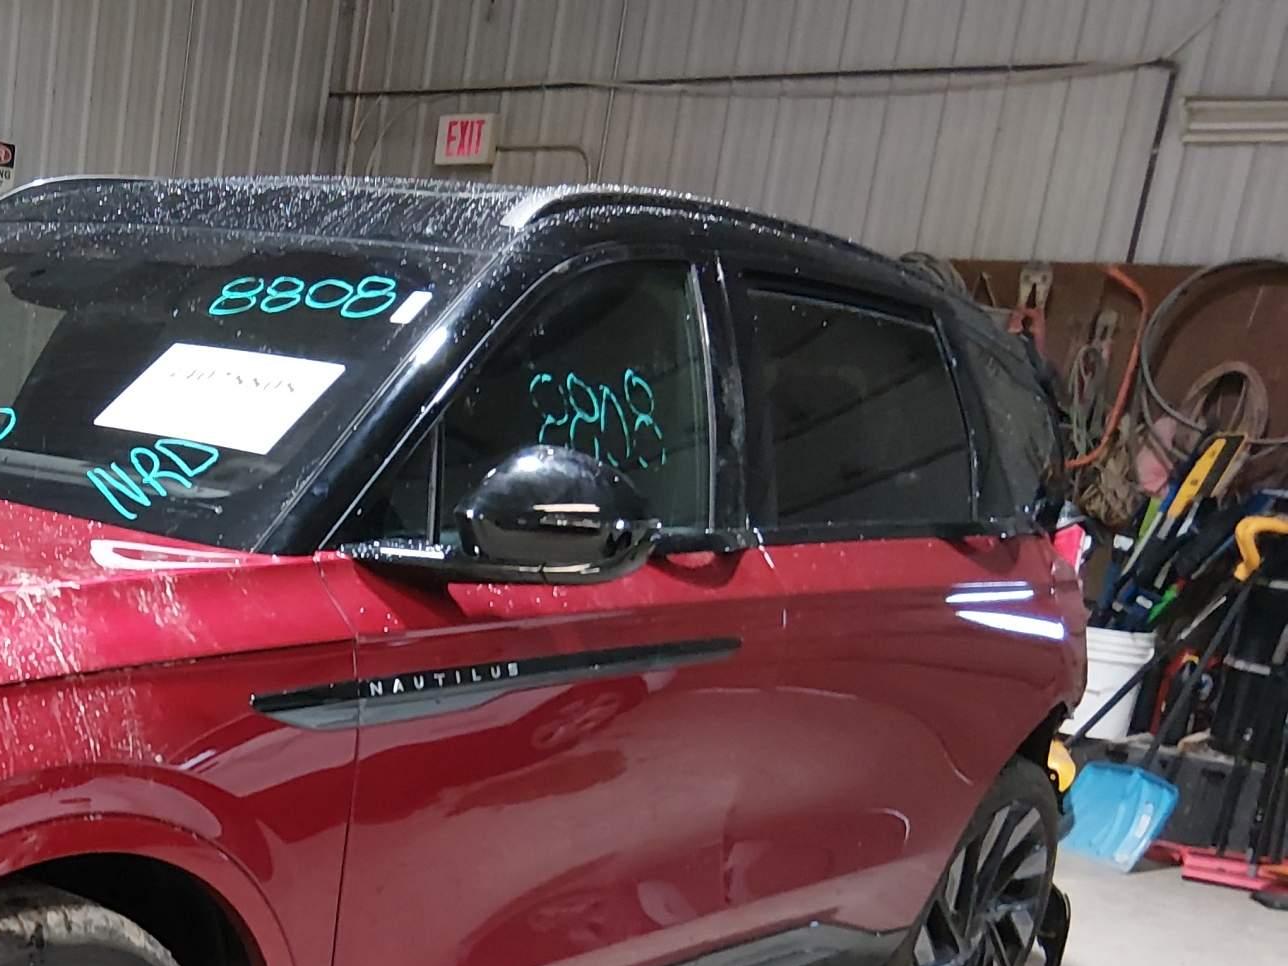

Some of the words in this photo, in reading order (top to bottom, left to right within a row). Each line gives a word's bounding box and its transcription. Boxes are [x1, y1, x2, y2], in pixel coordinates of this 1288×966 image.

[445, 119, 485, 157] EXIT
[207, 275, 399, 319] 8808
[86, 437, 220, 521] NRD
[369, 662, 519, 697] NAUTILUS
